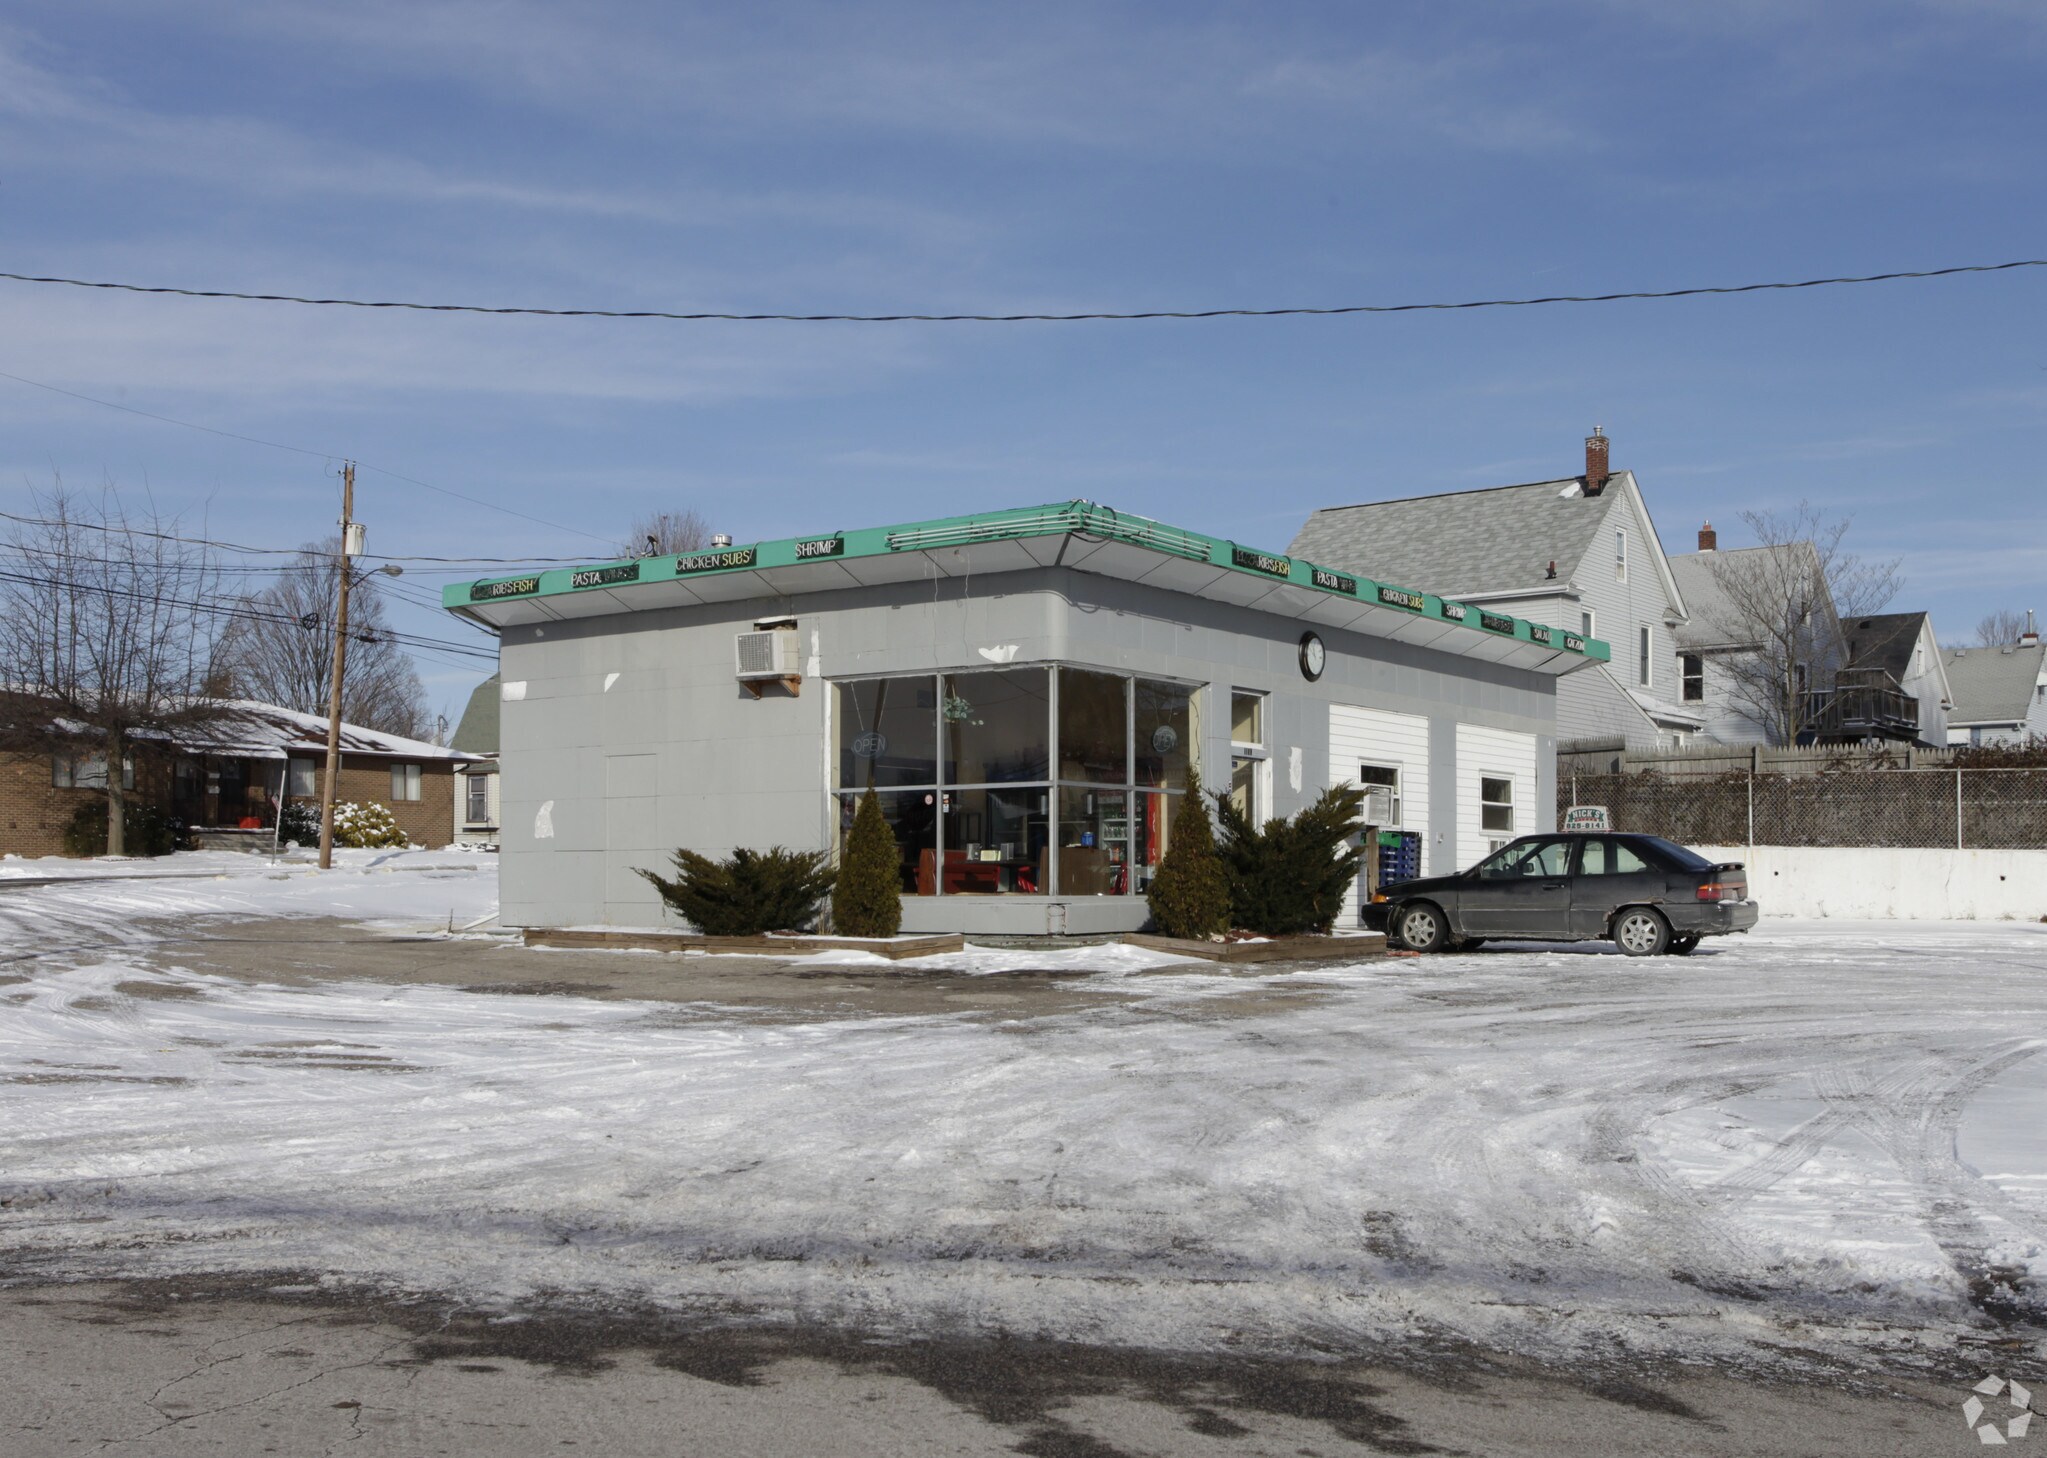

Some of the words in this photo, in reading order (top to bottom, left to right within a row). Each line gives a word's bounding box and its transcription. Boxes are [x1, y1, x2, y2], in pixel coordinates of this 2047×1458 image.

[795, 540, 835, 557] SHRIMP
[676, 554, 721, 571] CHICKEN
[722, 550, 751, 567] SUBS
[1258, 555, 1275, 572] RIBS
[1274, 559, 1291, 576] FISH
[493, 582, 513, 596] RIBS
[513, 579, 534, 593] FISH
[571, 572, 601, 587] PASTA
[1317, 571, 1339, 588] PASTA
[1409, 594, 1425, 609] SUBS
[854, 737, 886, 753] OPEN
[1572, 809, 1601, 818] NICK'S
